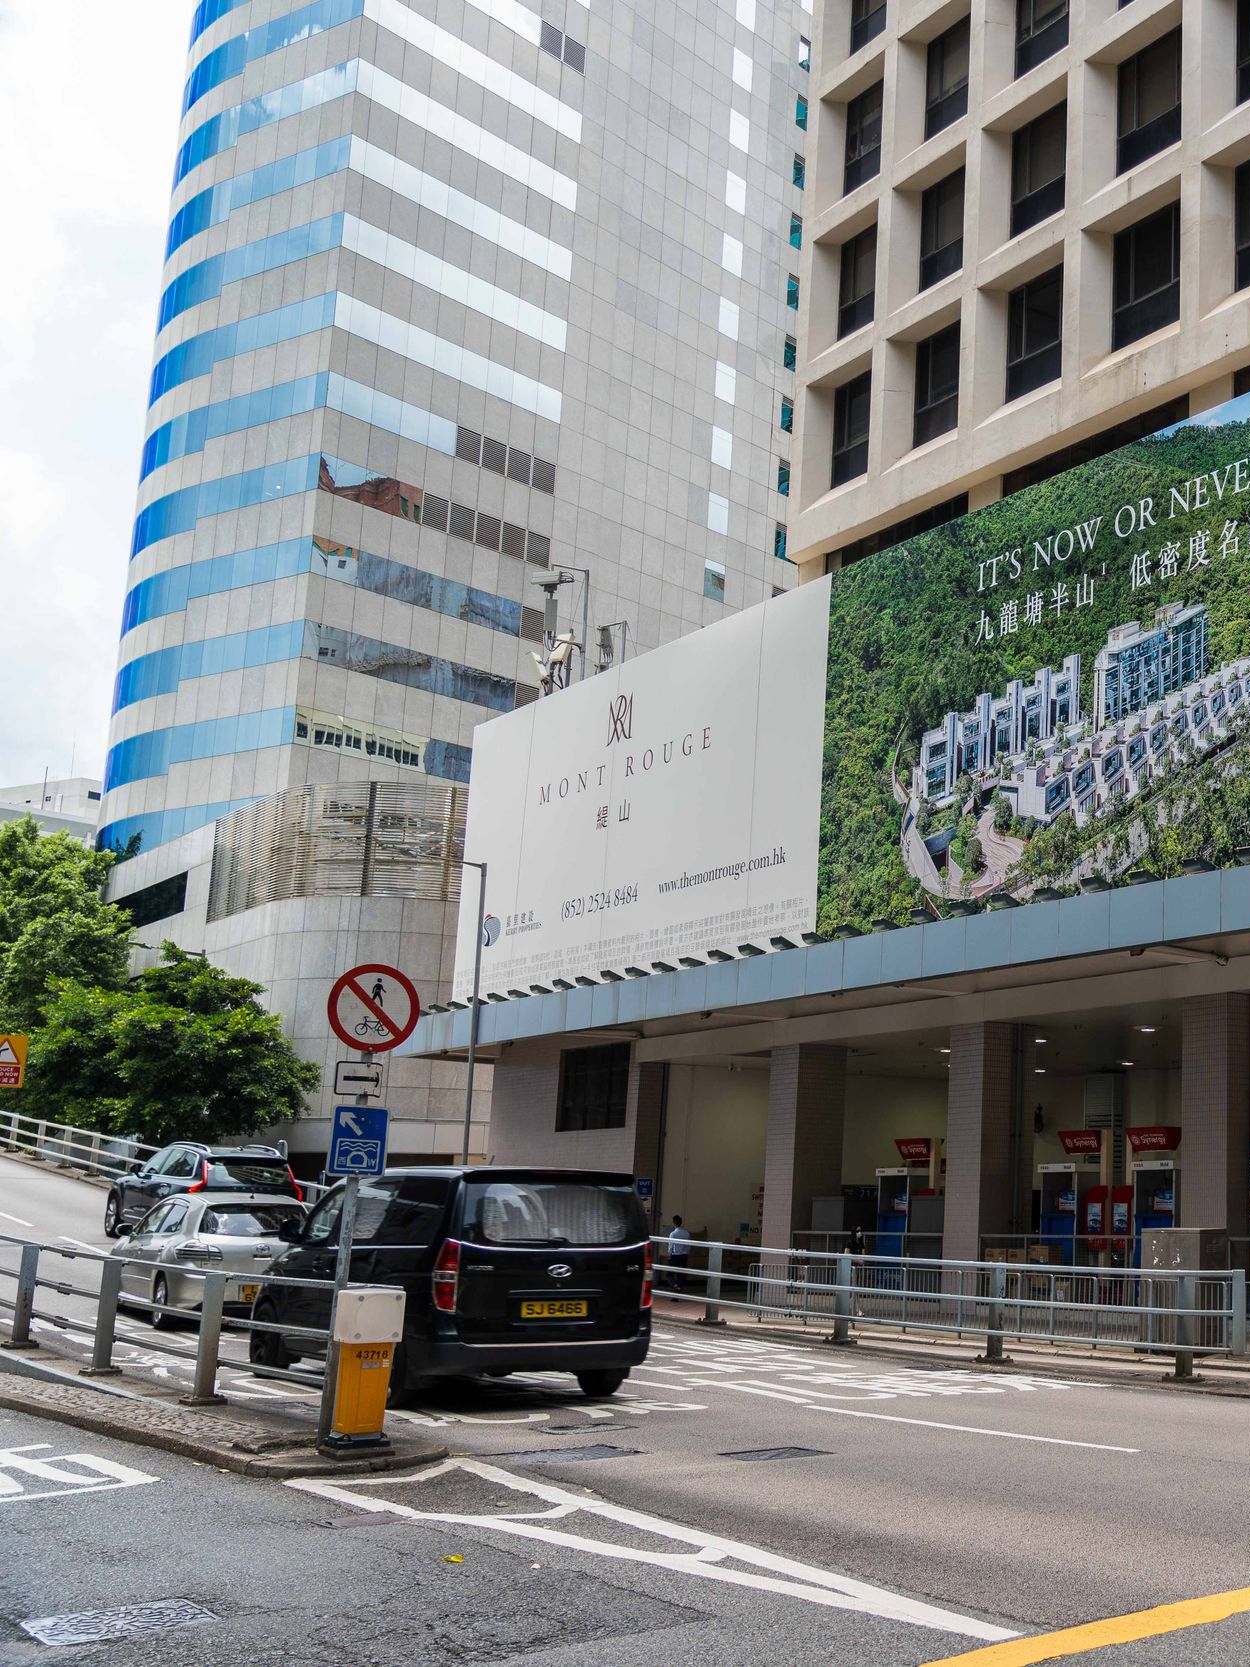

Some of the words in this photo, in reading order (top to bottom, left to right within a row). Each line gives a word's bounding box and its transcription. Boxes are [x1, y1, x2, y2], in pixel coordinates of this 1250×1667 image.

[976, 547, 1022, 592] IT'S
[1032, 515, 1104, 571] NOW
[1114, 497, 1157, 538] OR
[974, 573, 1096, 647] 九龍塘半山
[538, 765, 606, 806] MONT
[625, 726, 711, 777] ROUGE
[657, 847, 787, 895] www.themontrouge.com.hk
[561, 894, 586, 922] (852)
[588, 891, 611, 913] 2524
[613, 882, 639, 907] 8484
[367, 1158, 377, 1167] W
[525, 1303, 545, 1315] SJ
[547, 1302, 583, 1315] 6466
[355, 1350, 389, 1360] 43718
